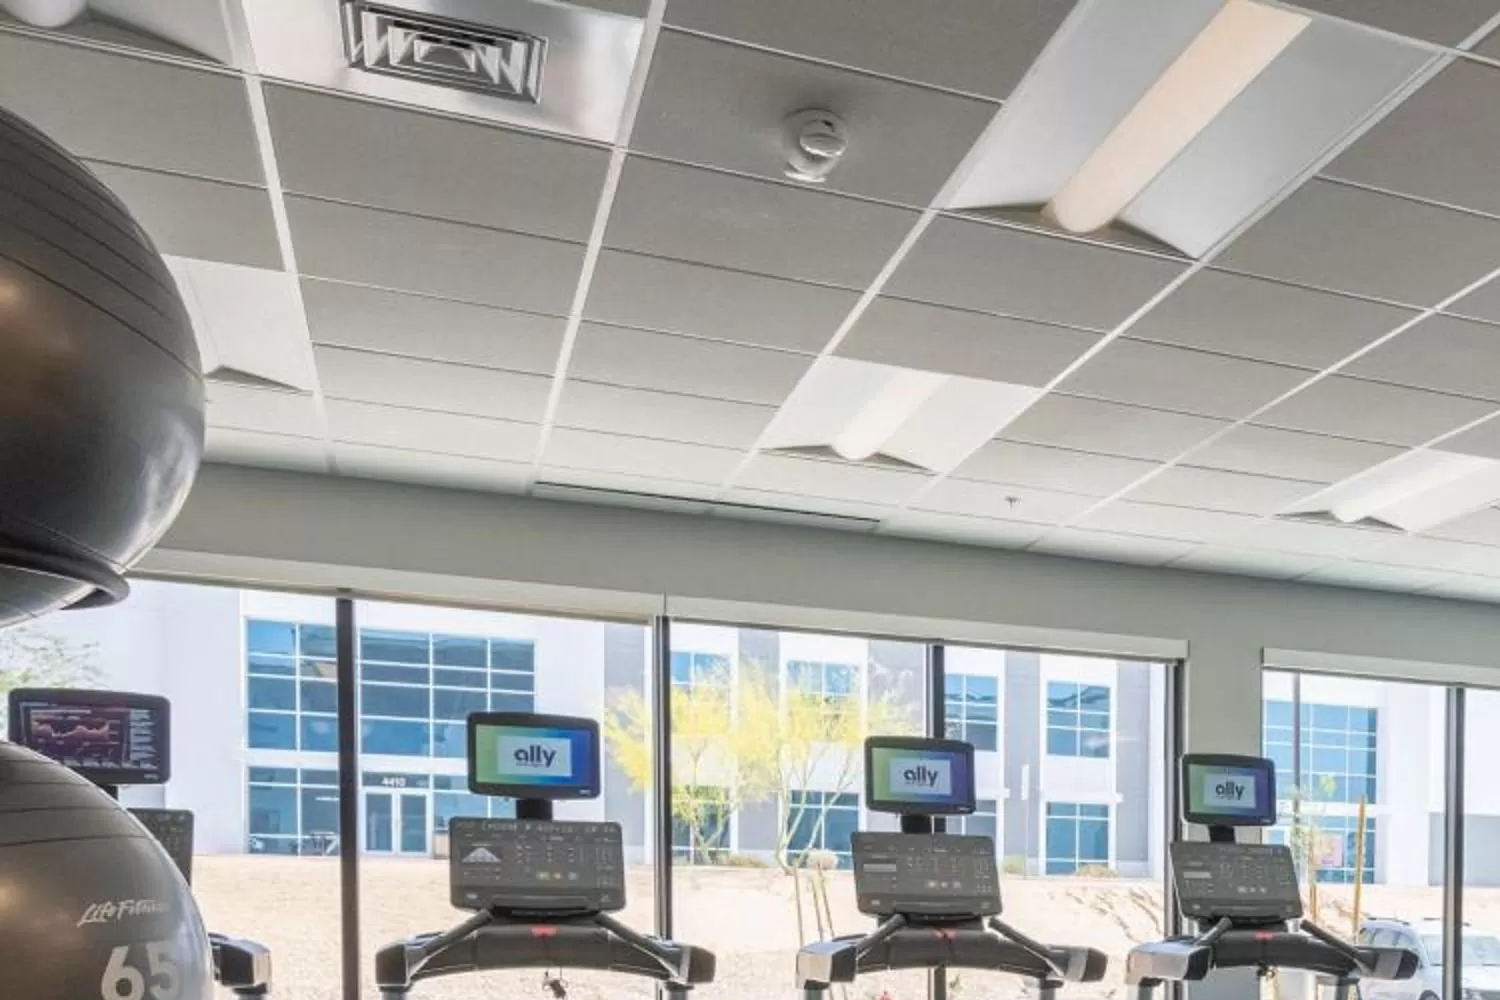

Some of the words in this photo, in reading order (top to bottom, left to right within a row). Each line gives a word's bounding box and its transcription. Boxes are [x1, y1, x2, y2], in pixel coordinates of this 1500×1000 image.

[514, 744, 556, 768] ally
[903, 765, 938, 788] ally
[1215, 781, 1246, 800] ally
